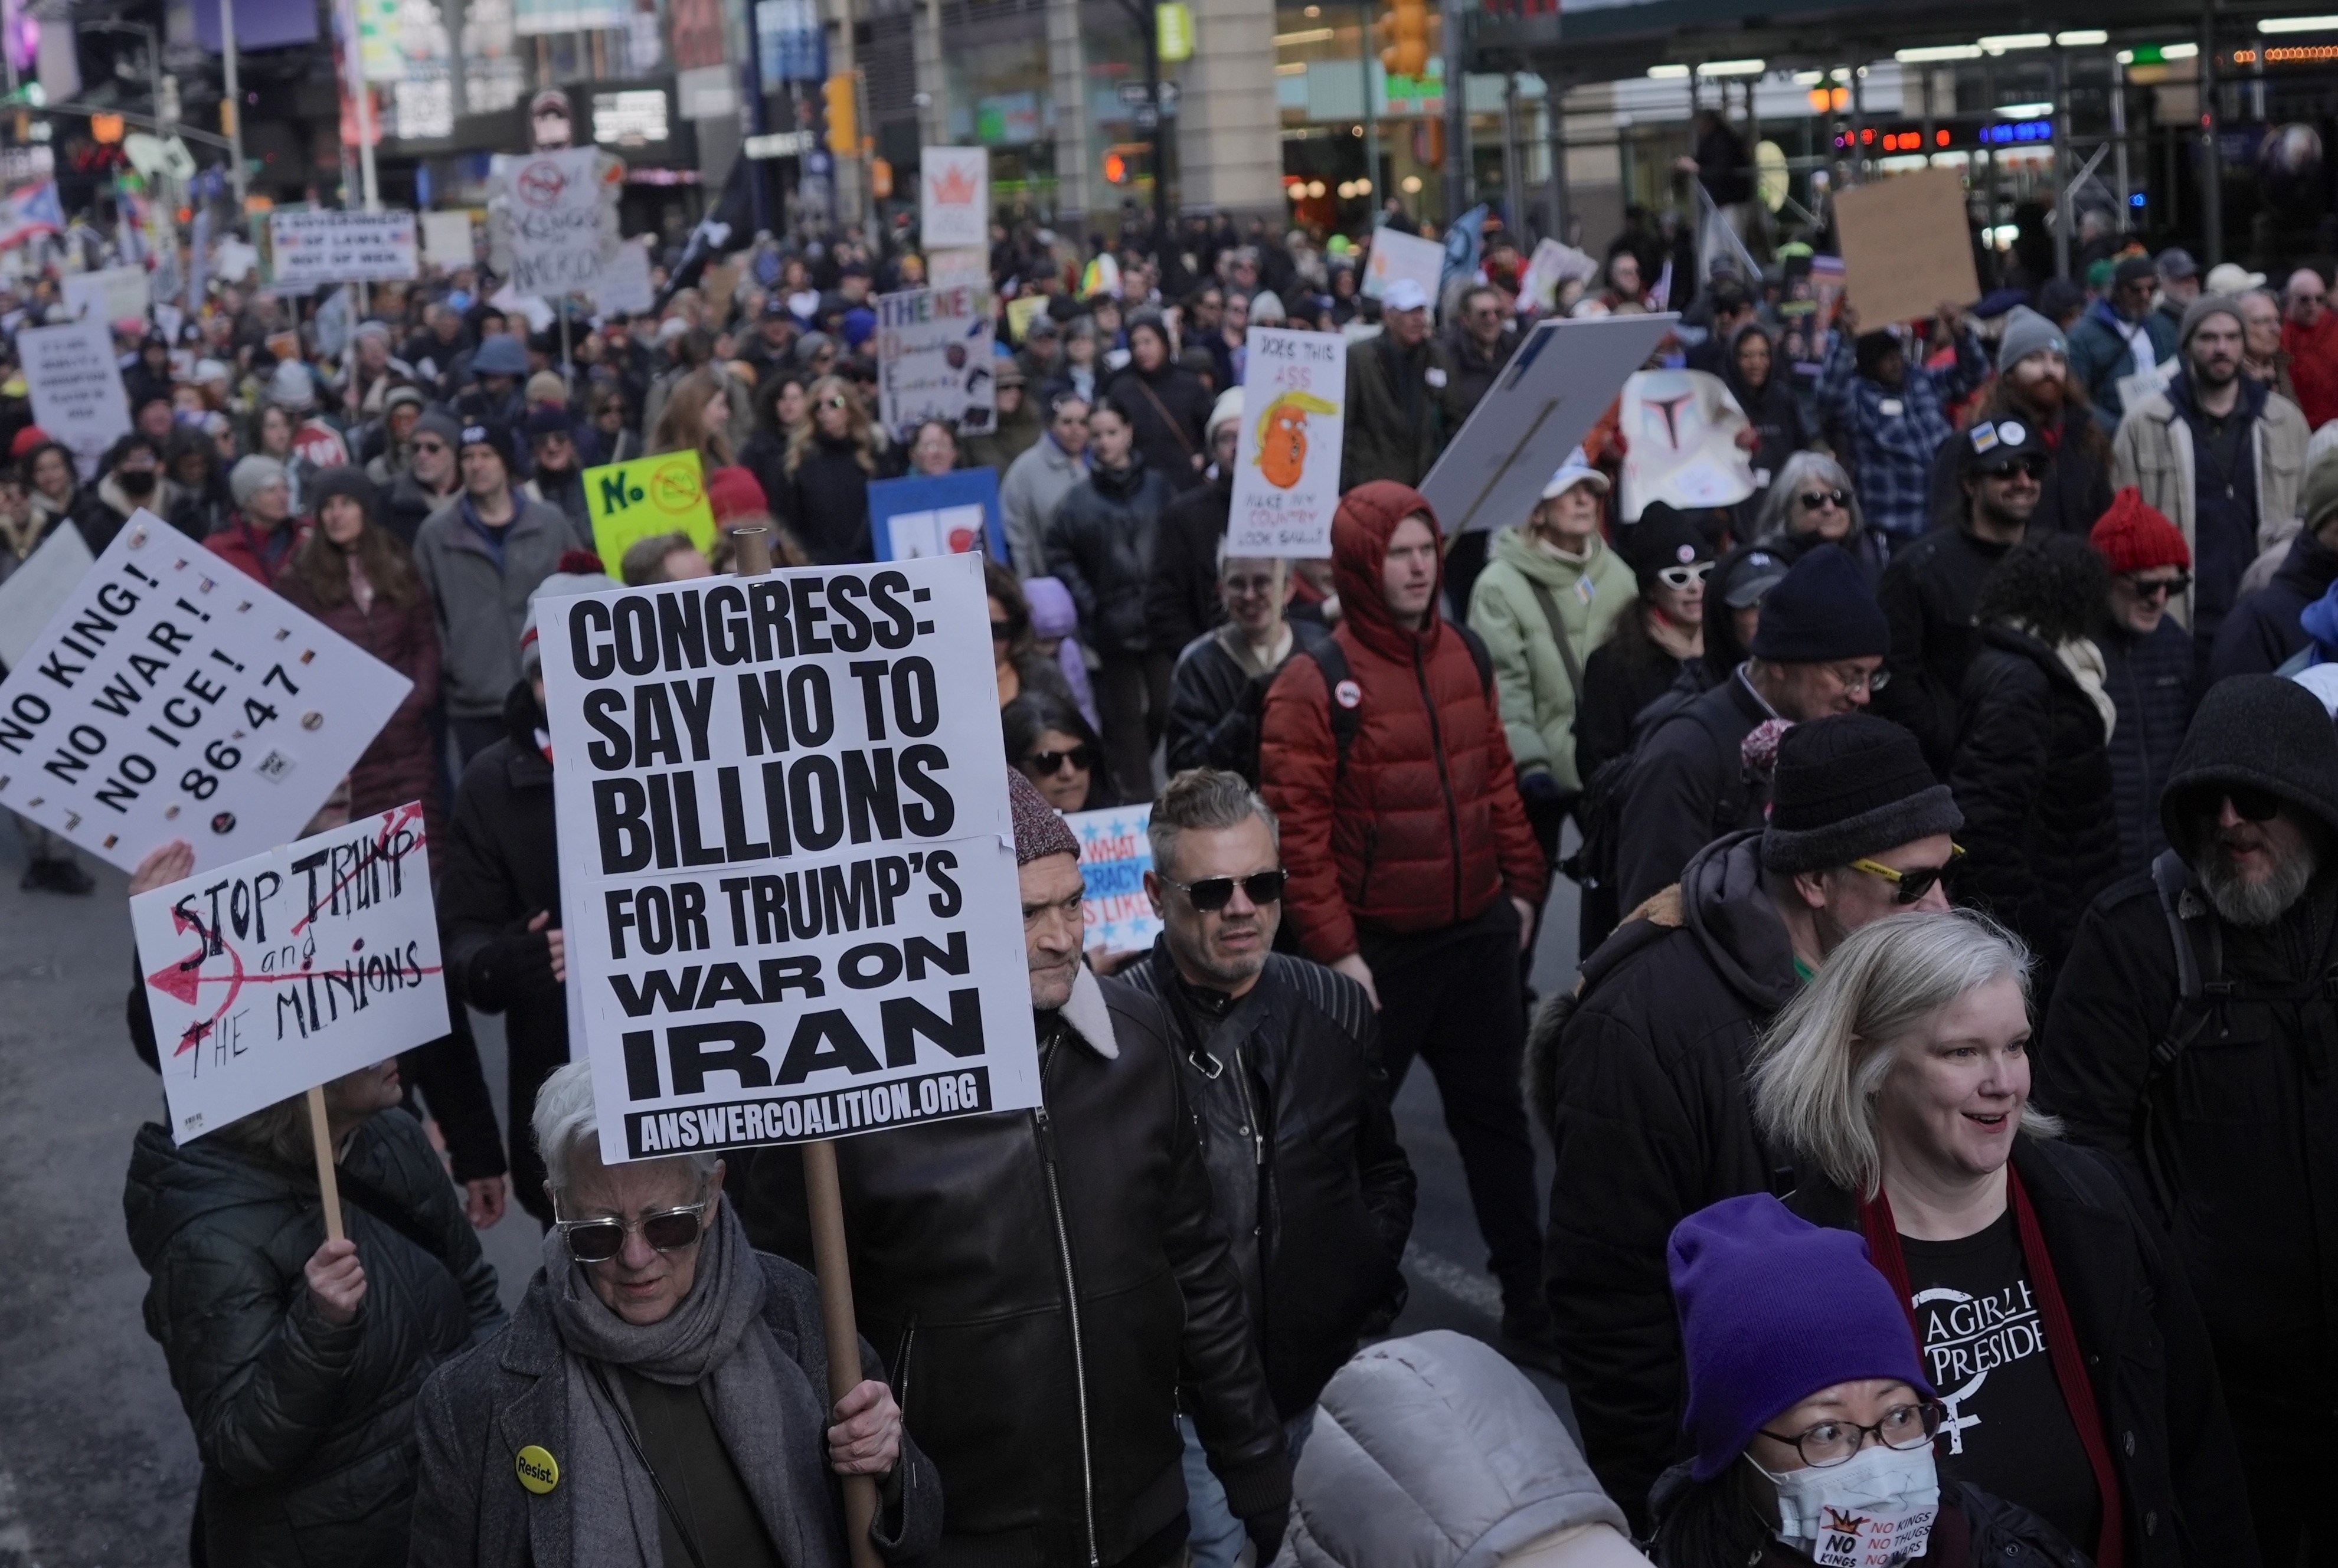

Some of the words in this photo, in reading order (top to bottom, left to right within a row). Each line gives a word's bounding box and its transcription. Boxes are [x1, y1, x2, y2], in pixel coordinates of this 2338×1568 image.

[882, 292, 931, 326] THE
[1261, 335, 1296, 361] DOES
[1303, 341, 1335, 362] THIS
[1275, 365, 1312, 390] ASS
[0, 693, 51, 755] NO
[38, 562, 160, 690] KING!
[568, 570, 936, 681] CONGRESS:
[43, 724, 107, 785] NO
[91, 597, 211, 718] WAR!
[582, 676, 715, 771] SAY
[737, 664, 835, 757] NO
[849, 655, 940, 741] TO
[94, 754, 156, 814] NO
[146, 649, 245, 748] ICE!
[591, 744, 955, 875] BILLIONS
[175, 871, 283, 971] STOP
[290, 830, 414, 924] TRUMP
[604, 880, 710, 960] FOR
[719, 849, 963, 947] TRUMP'S
[1101, 892, 1150, 923] LIKE
[260, 925, 316, 973] and
[607, 954, 826, 1017] WAR
[837, 931, 970, 990] ON
[181, 1008, 250, 1079] THE
[276, 938, 423, 1041] MINIONS
[622, 987, 986, 1102] IRAN
[640, 1072, 979, 1153] ANSWERCOALITION.ORG
[1927, 1310, 1951, 1343] A
[1950, 1287, 2016, 1336] GIRL
[1931, 1319, 2048, 1386] PRESIDE
[518, 1456, 554, 1484] Resist.
[1825, 1534, 1856, 1554] NO
[1868, 1538, 1891, 1550] NO
[1894, 1525, 1932, 1547] THUGS
[1870, 1523, 1895, 1534] NO
[1895, 1511, 1932, 1532] KINGS
[1819, 1553, 1857, 1568] KINGS
[1865, 1554, 1889, 1566] NO
